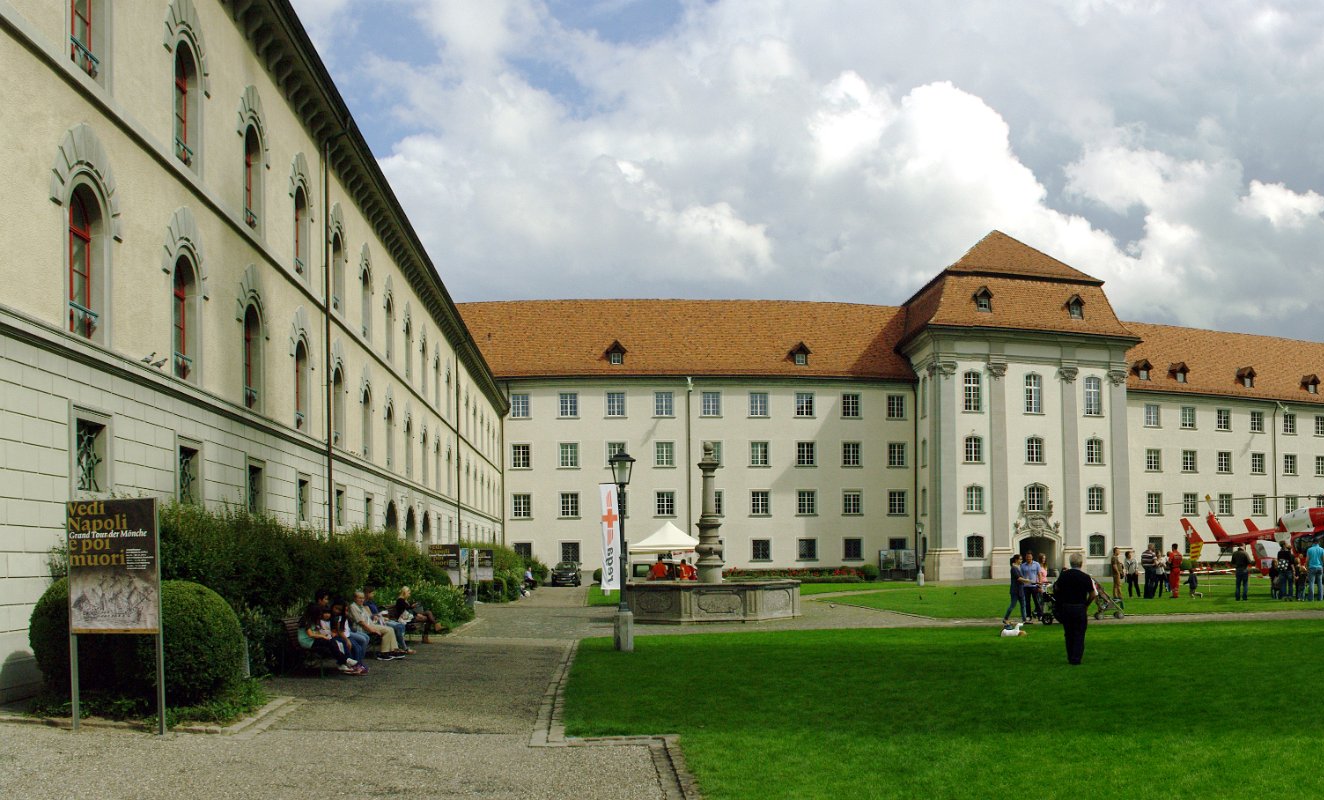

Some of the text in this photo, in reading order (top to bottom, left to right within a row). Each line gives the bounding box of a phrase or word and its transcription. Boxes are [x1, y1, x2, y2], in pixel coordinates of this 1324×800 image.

[68, 501, 105, 516] Vedi
[68, 513, 128, 532] Napoli
[69, 528, 148, 539] Grand Tour der Mönche
[69, 538, 111, 553] e poi
[69, 549, 126, 567] muori
